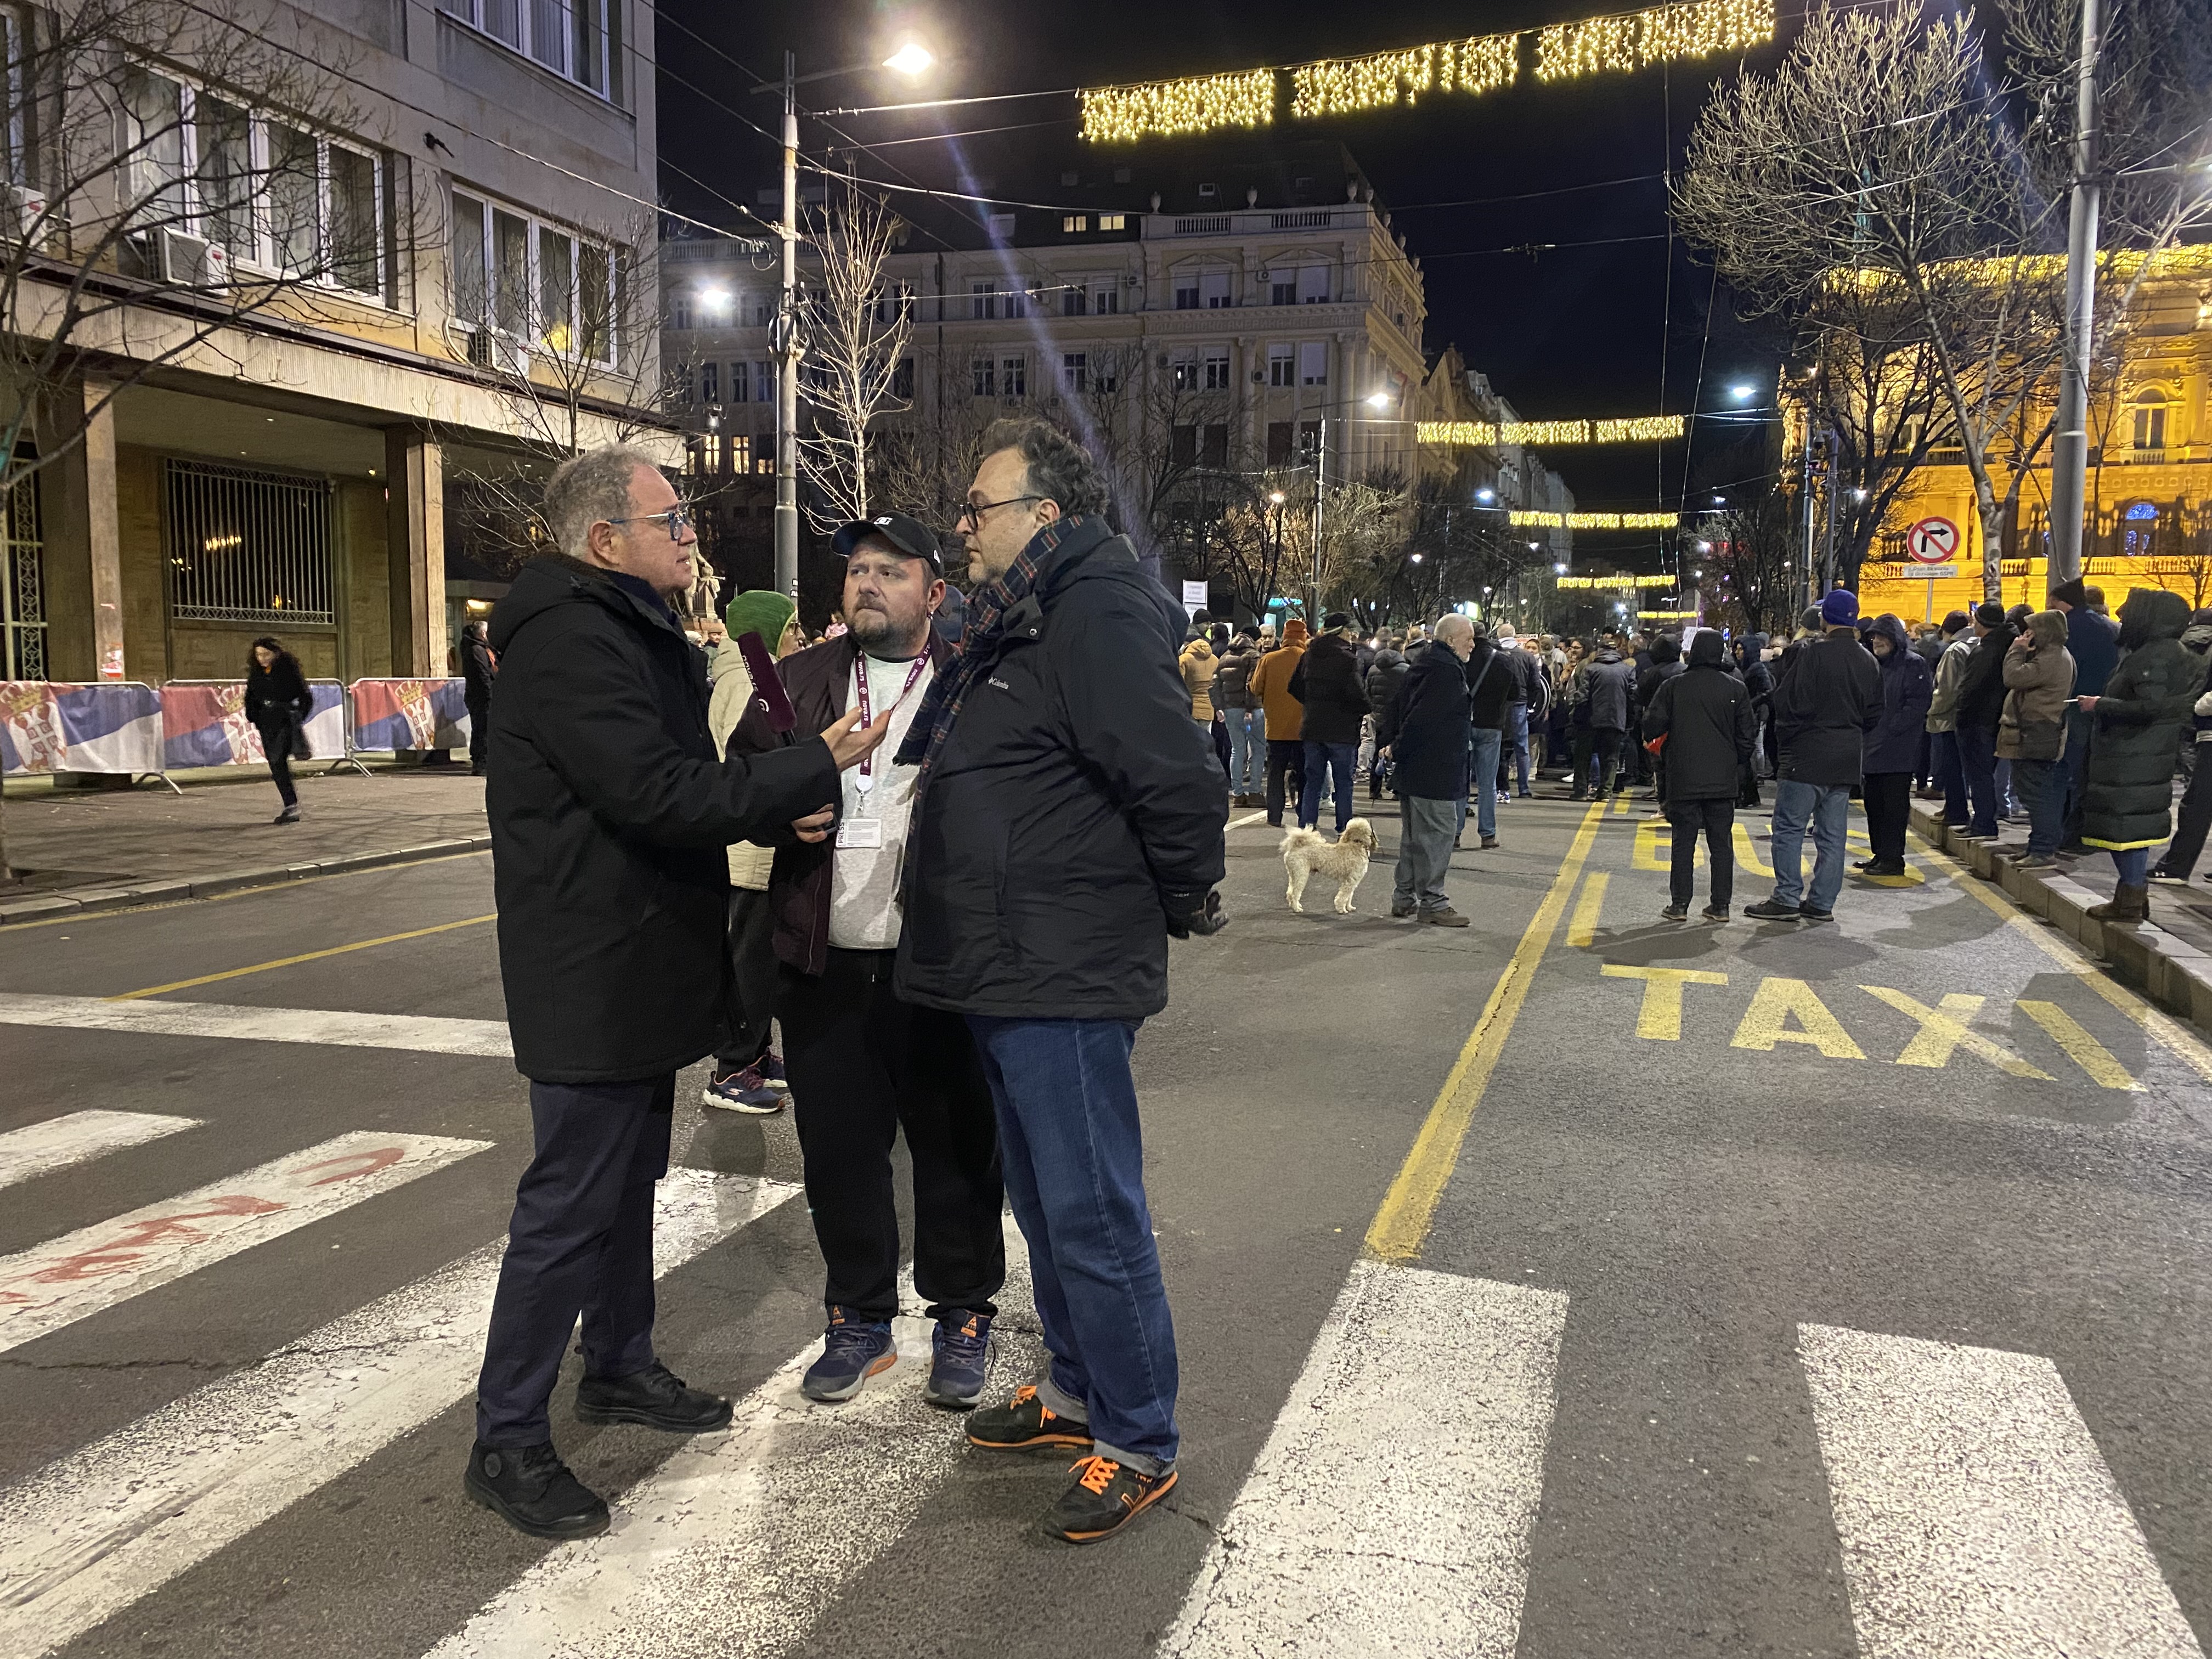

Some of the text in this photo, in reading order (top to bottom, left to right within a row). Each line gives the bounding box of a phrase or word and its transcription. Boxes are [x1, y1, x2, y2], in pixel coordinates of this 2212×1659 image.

[742, 655, 759, 692] novars
[906, 669, 918, 687] nova.rs
[1600, 964, 2148, 1091] TAXI
